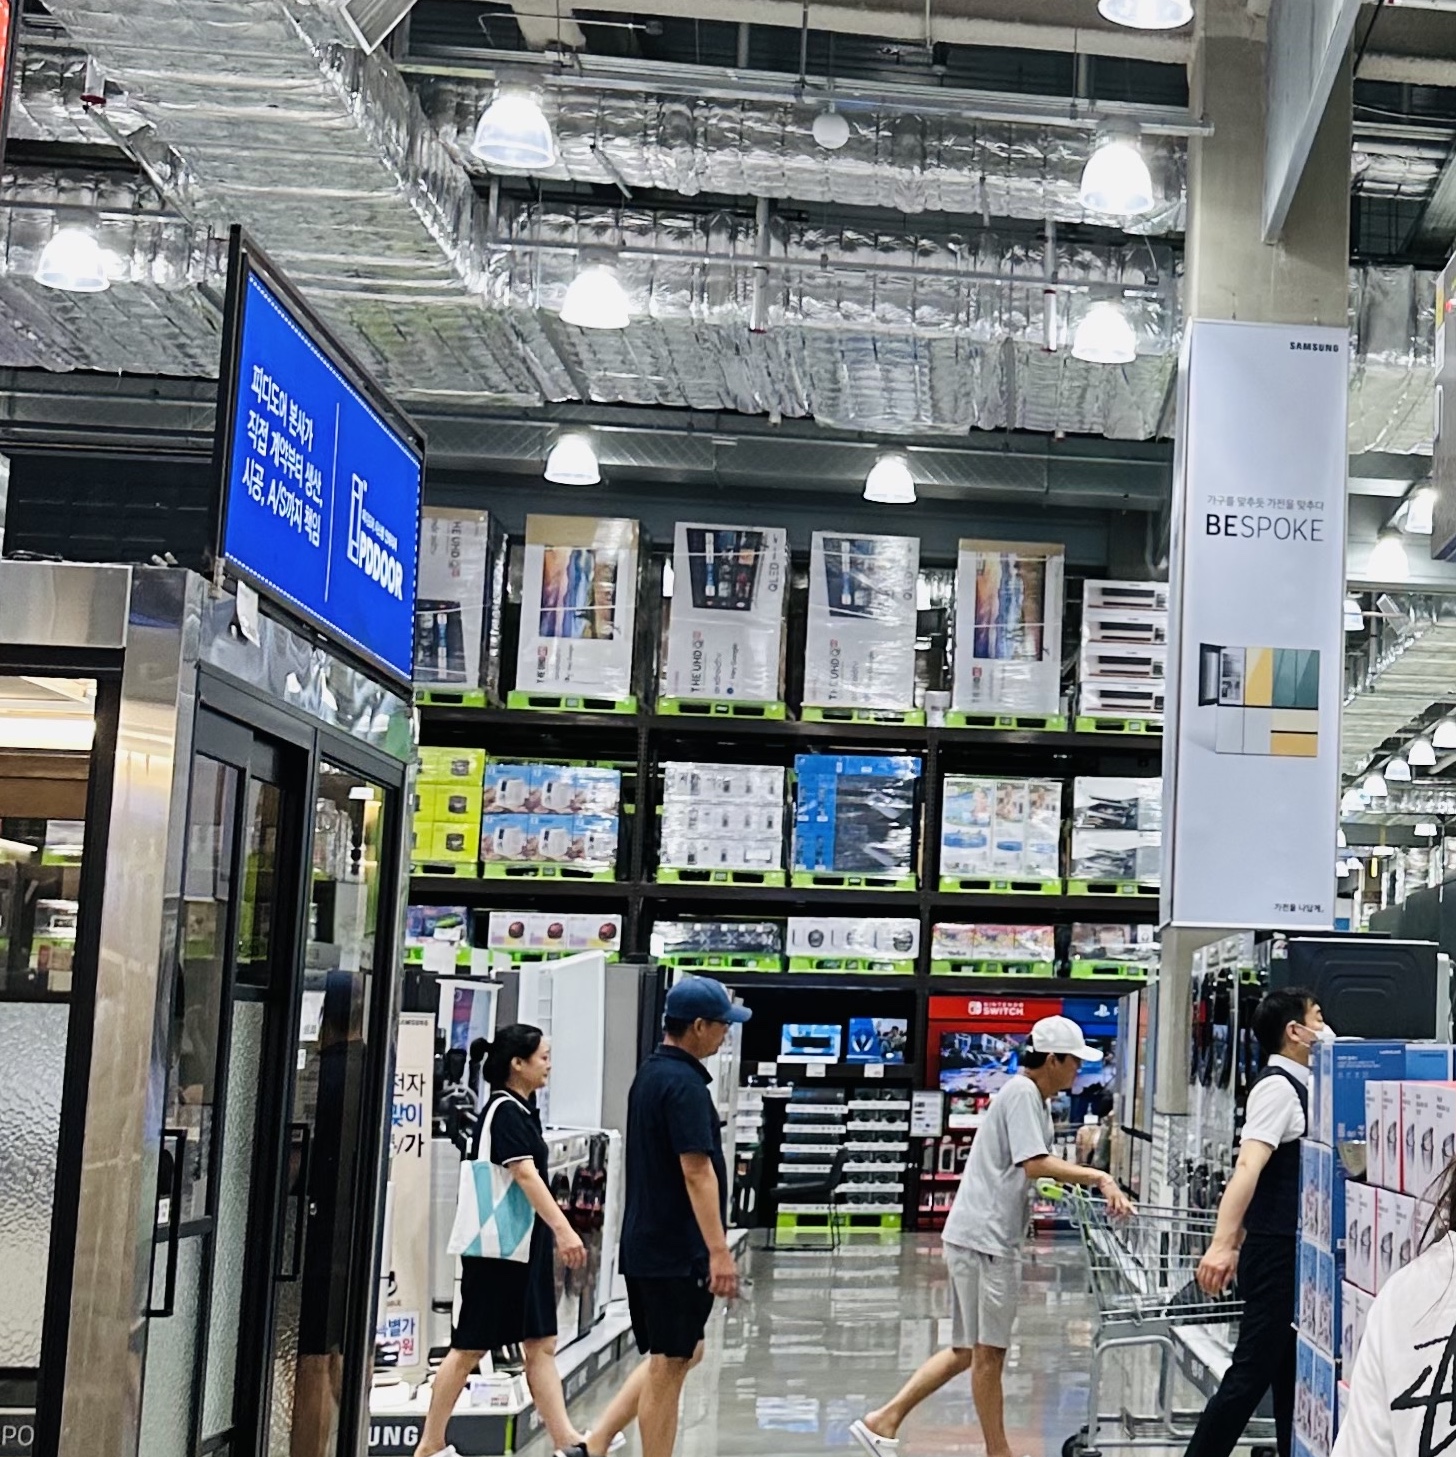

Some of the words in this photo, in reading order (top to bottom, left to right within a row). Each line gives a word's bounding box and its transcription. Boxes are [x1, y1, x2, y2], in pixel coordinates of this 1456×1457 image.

[1289, 341, 1339, 353] SAMSUNG
[251, 364, 288, 427] 피디도어
[288, 398, 314, 453] 본사가
[247, 409, 269, 457] 직접
[269, 429, 304, 489] 계약부터
[242, 456, 265, 507] 시공,
[266, 477, 304, 534] A/S까지
[1206, 513, 1325, 542] BESPOKE
[358, 530, 403, 601] PDDOOR
[983, 1006, 1025, 1016] SWITCH
